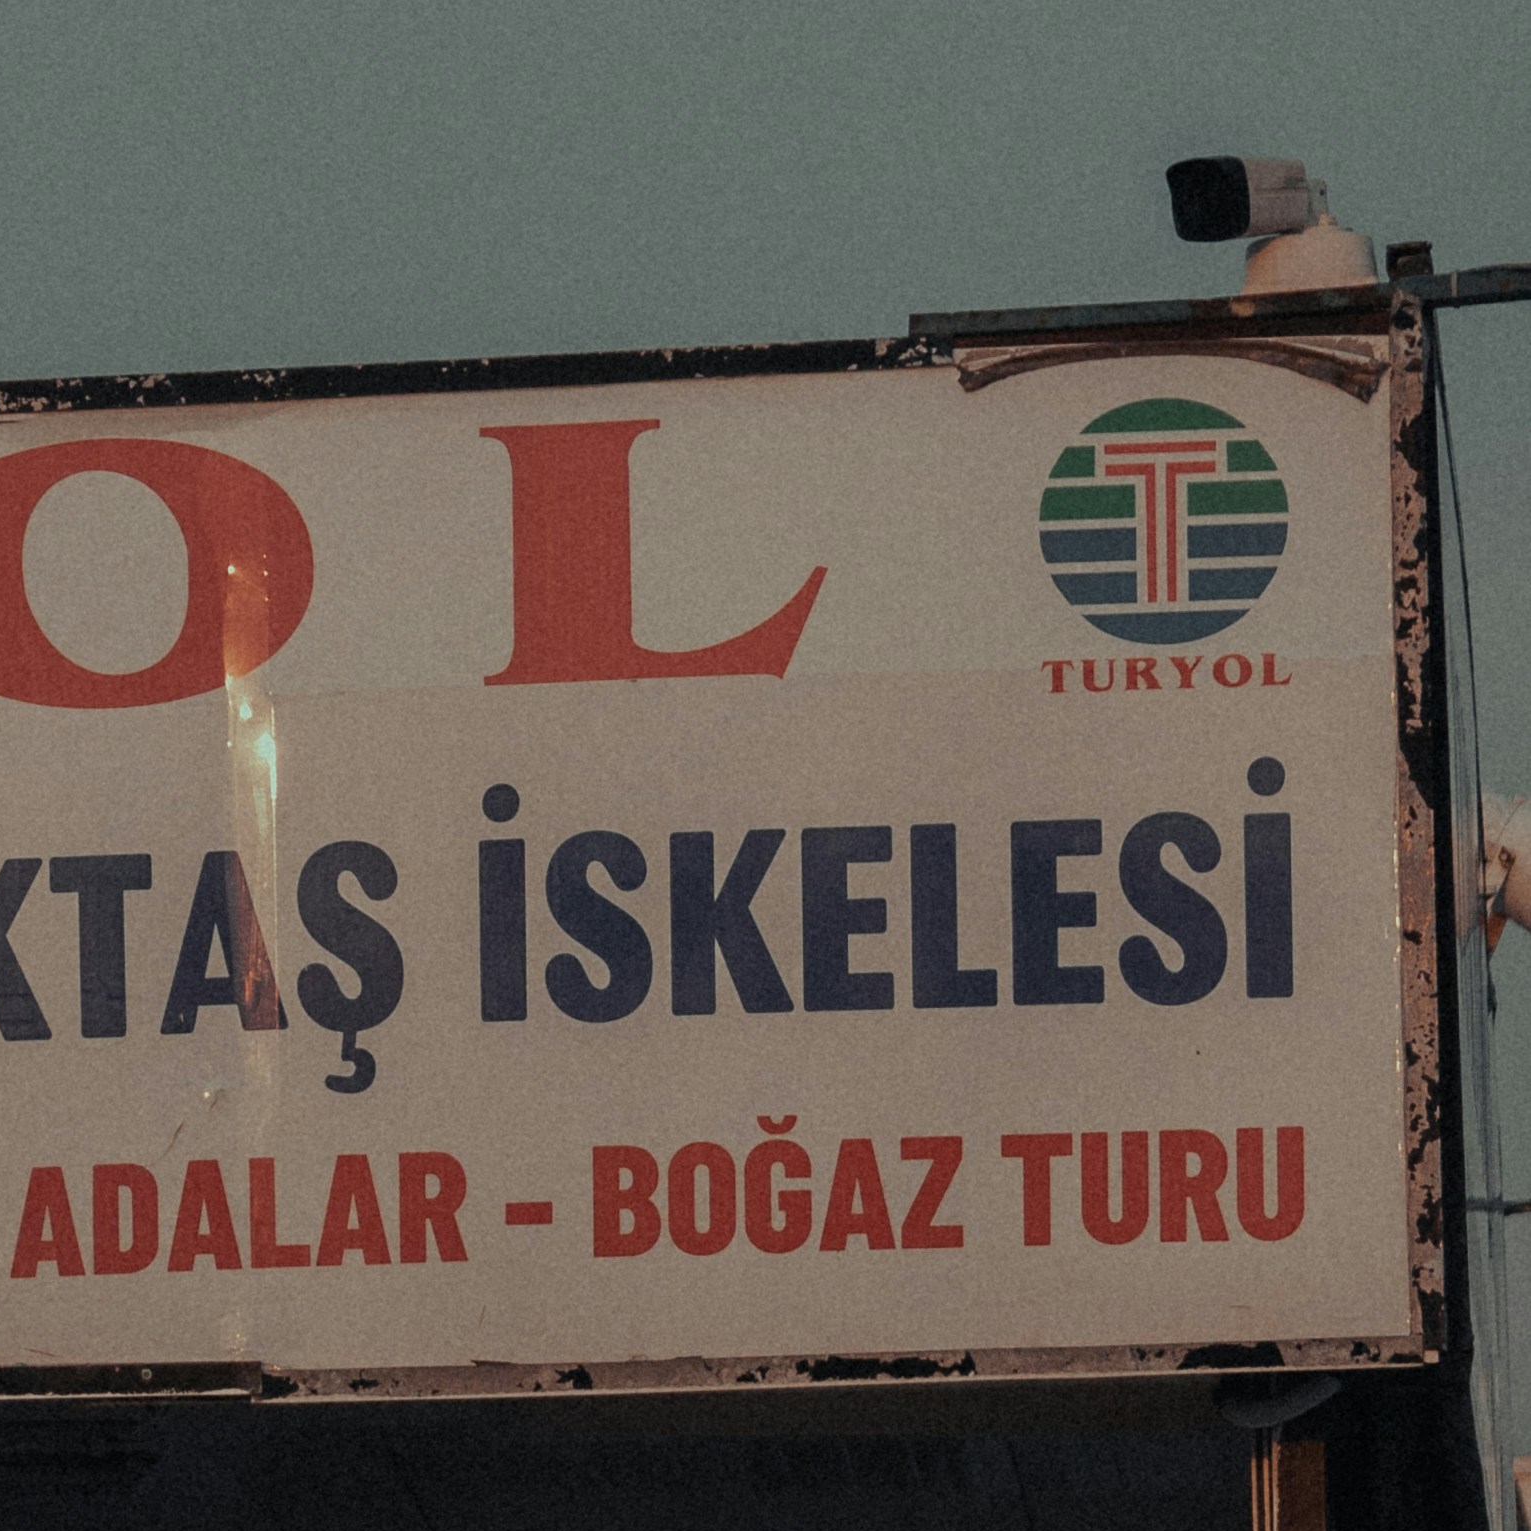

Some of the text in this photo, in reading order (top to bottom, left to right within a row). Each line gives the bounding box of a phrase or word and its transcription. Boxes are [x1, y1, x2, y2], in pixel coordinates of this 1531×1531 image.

[1041, 653, 1292, 694] TURYOL
[478, 757, 1294, 1022] İSKELESİ
[11, 1151, 467, 1279] ADALAR
[592, 1114, 964, 1258] BOĞAZ
[1000, 1127, 1306, 1247] TURU
